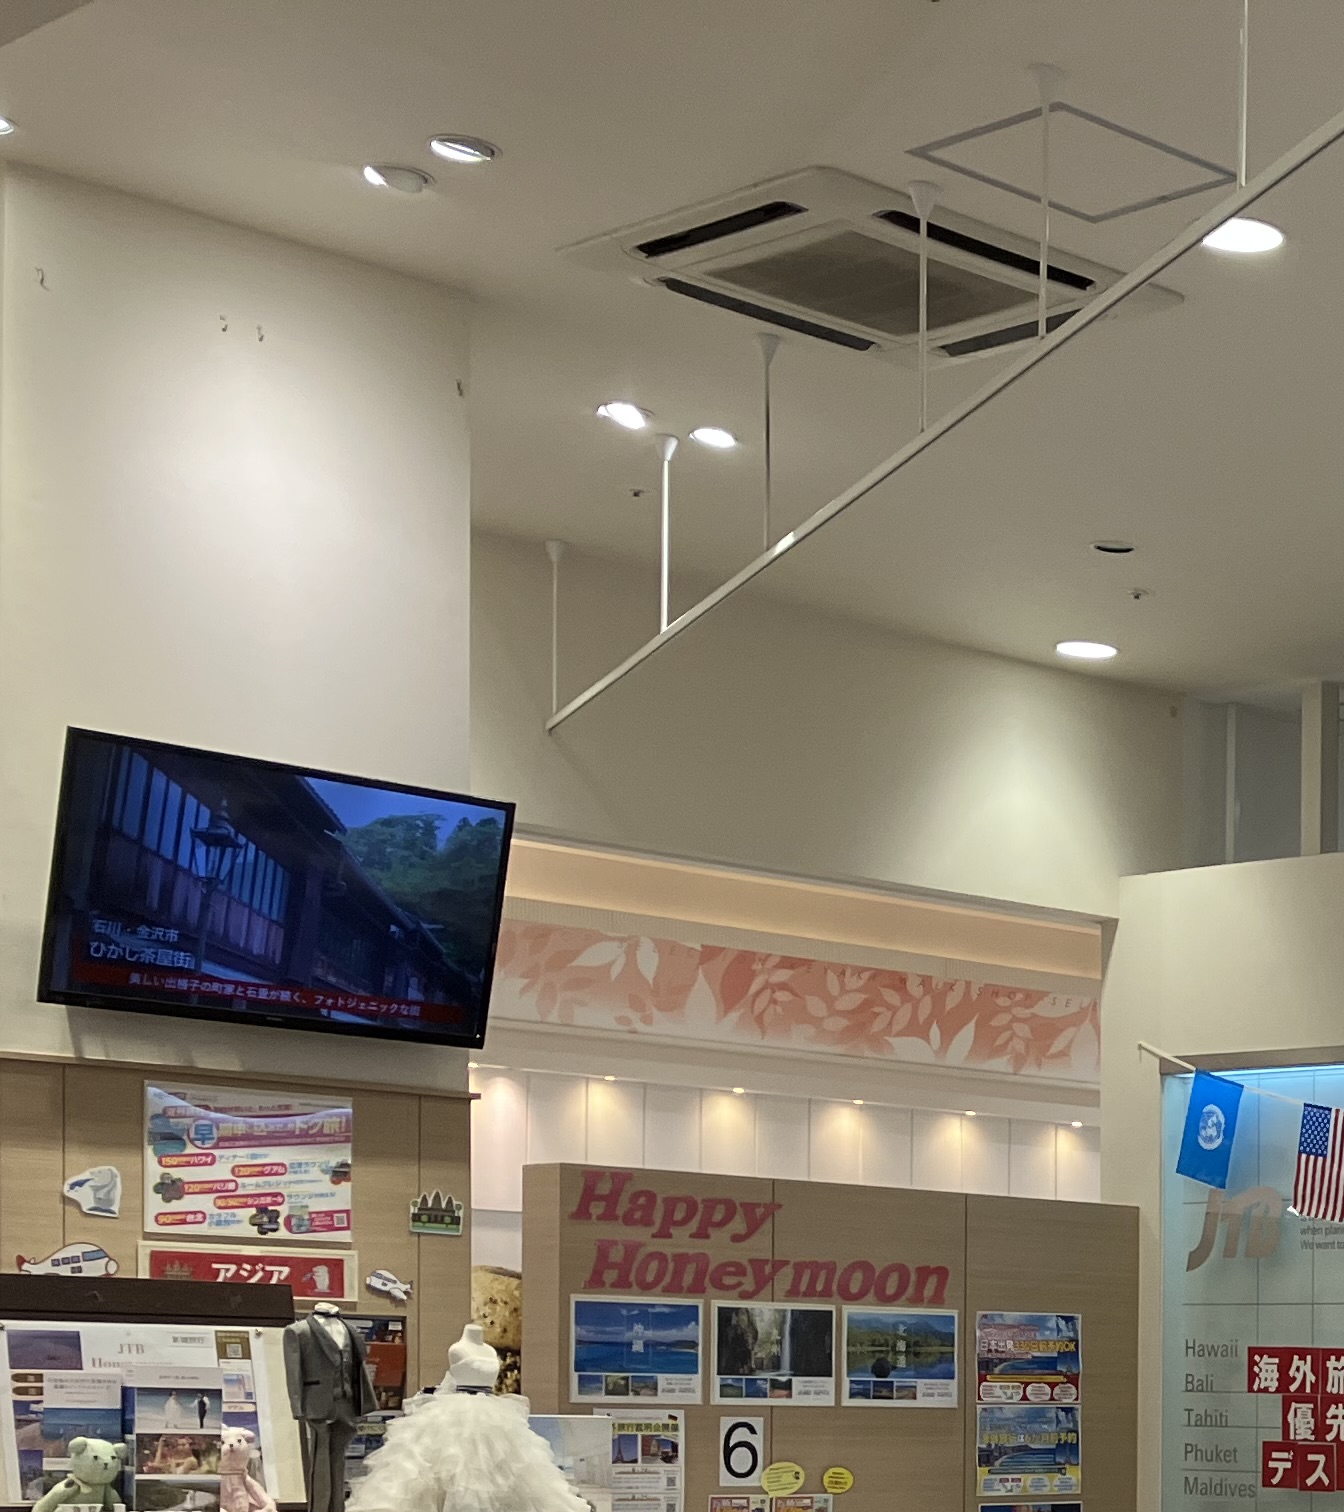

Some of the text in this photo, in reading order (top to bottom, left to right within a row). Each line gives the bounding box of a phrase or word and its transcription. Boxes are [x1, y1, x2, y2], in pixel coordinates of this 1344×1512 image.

[569, 1169, 784, 1244] Happy
[1316, 1239, 1335, 1250] want
[211, 1262, 291, 1285] アジア
[582, 1239, 952, 1306] Honeymoon
[1184, 1338, 1239, 1359] Hawaii
[1184, 1373, 1214, 1393] Bali
[1183, 1408, 1229, 1428] Tahiti
[722, 1420, 760, 1480] 6
[1184, 1442, 1239, 1464] Phuket
[1183, 1476, 1257, 1499] Maldives
